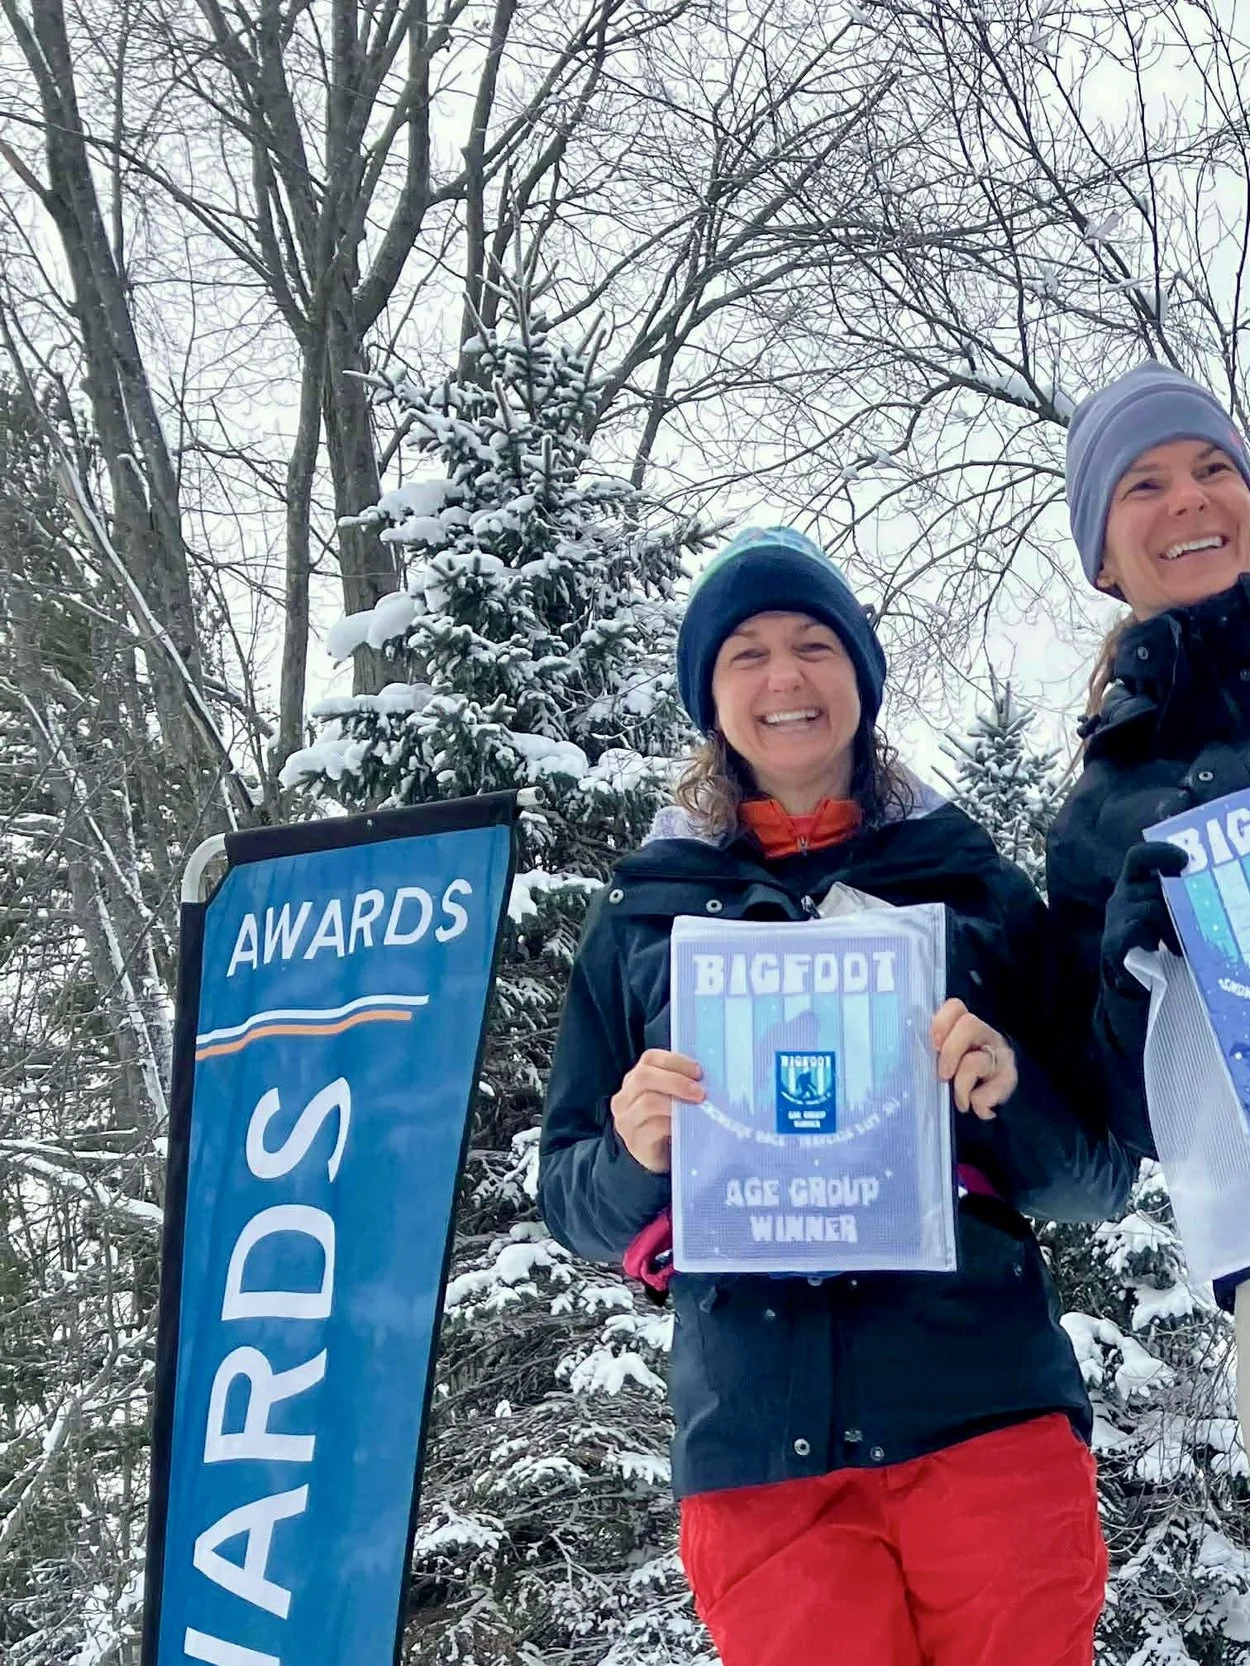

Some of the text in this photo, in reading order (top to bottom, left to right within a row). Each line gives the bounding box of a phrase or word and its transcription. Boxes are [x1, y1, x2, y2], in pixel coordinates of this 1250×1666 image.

[226, 879, 473, 978] AWARDS
[693, 950, 897, 996] BIGFOOT
[725, 1176, 880, 1208] AGE GROUP
[749, 1213, 859, 1243] WINNER
